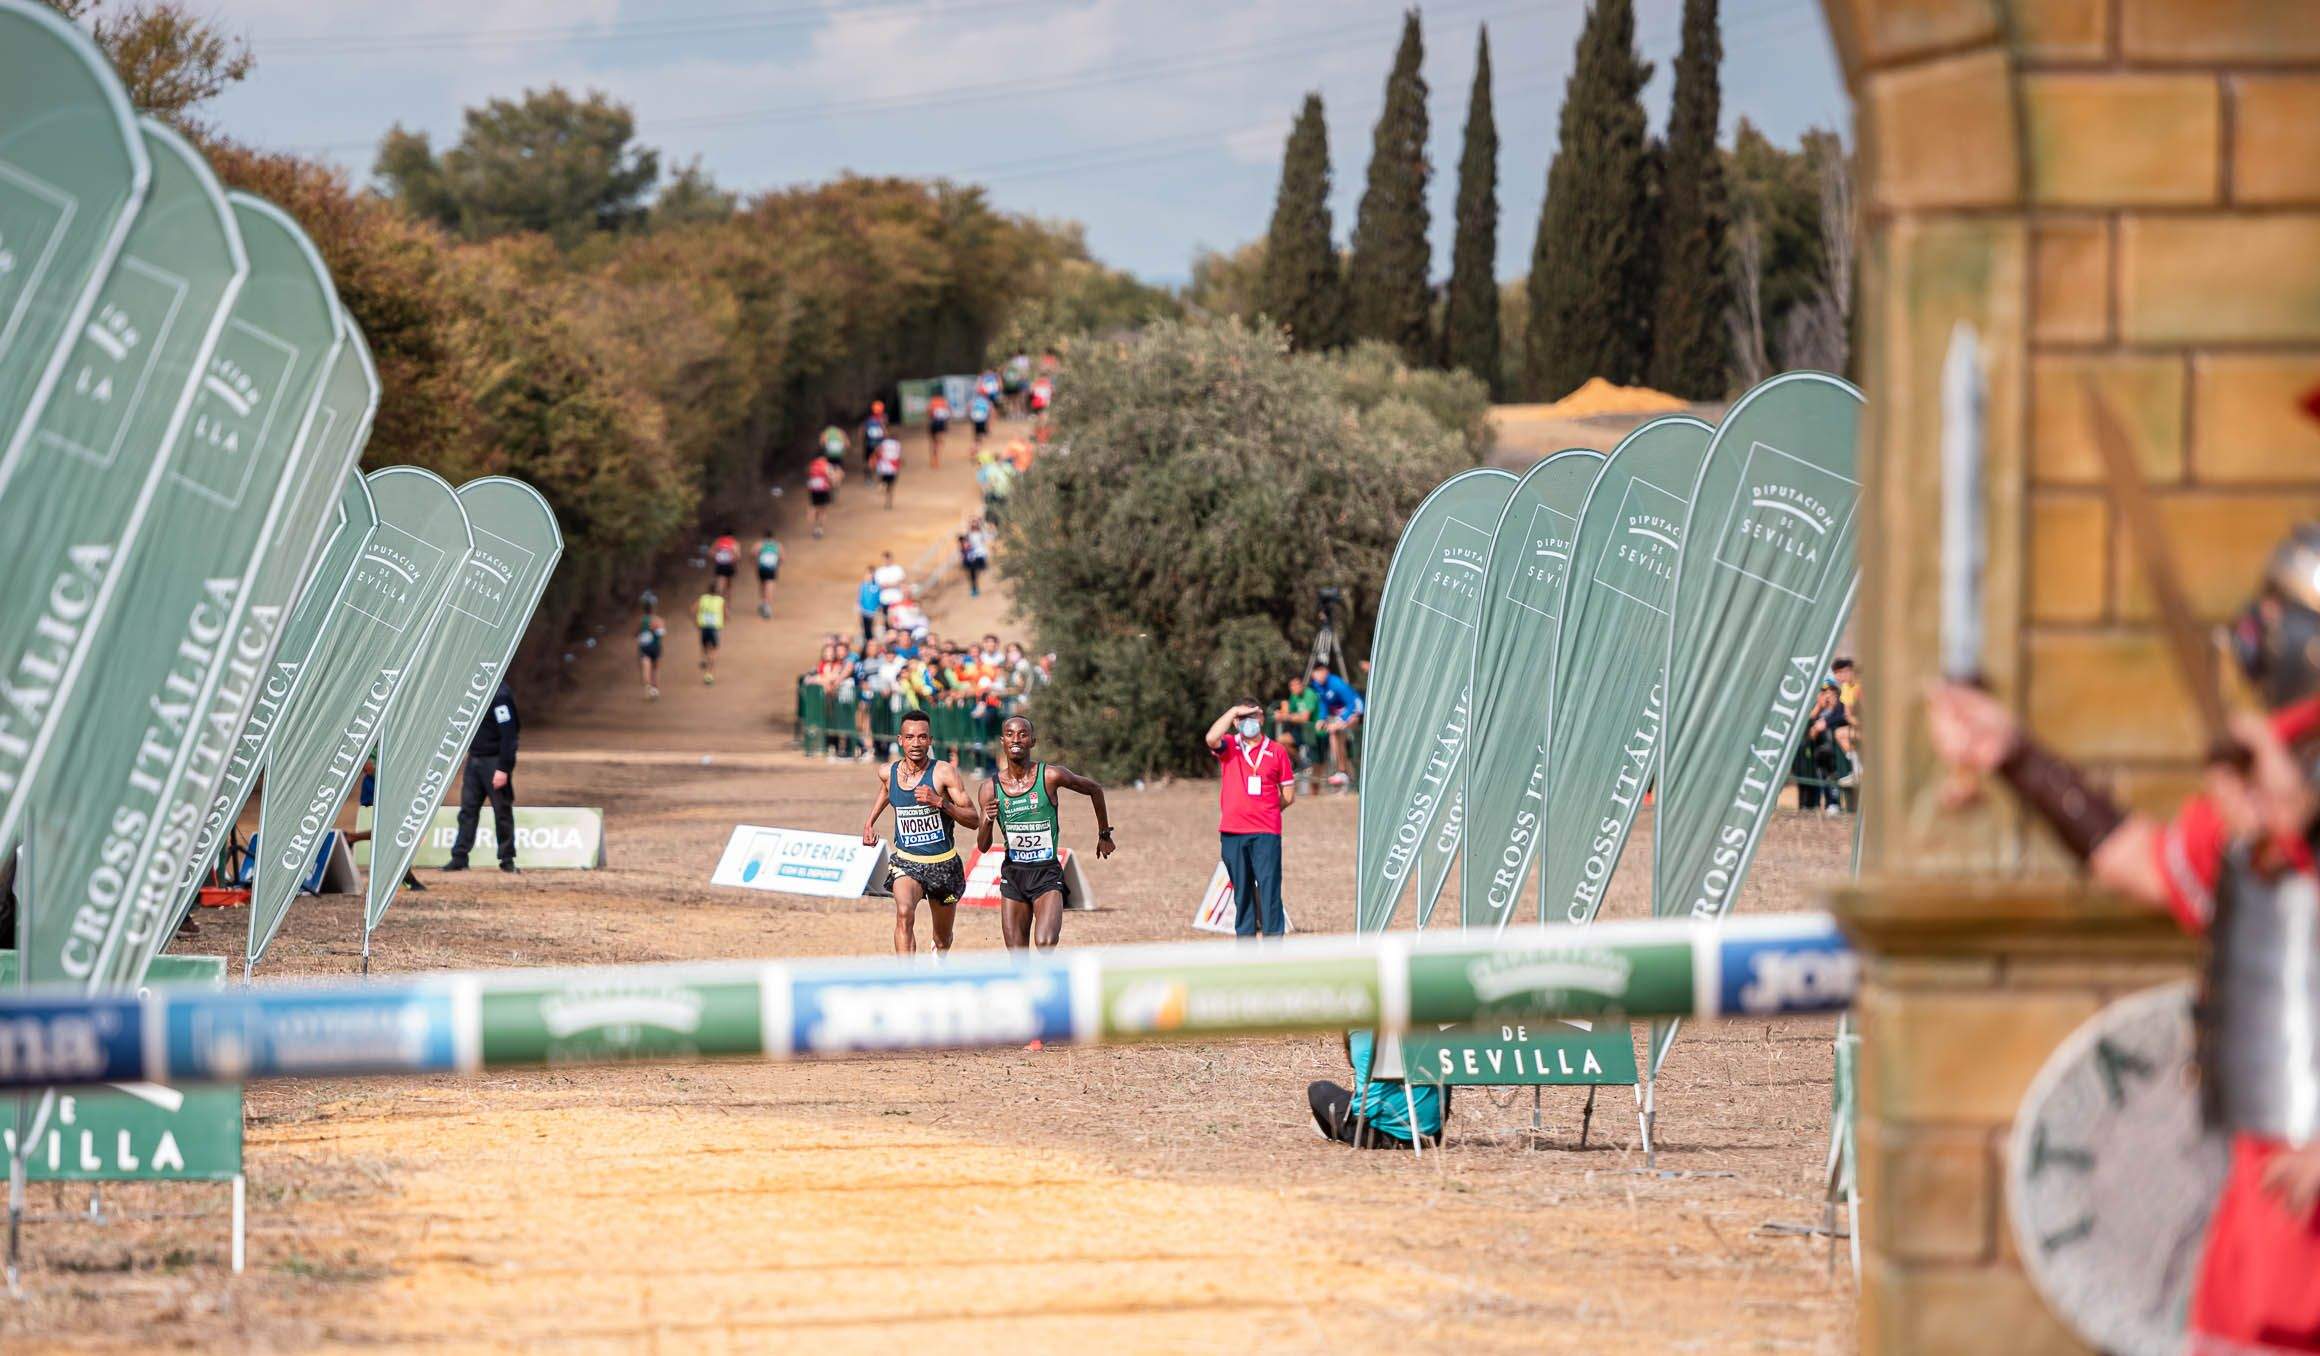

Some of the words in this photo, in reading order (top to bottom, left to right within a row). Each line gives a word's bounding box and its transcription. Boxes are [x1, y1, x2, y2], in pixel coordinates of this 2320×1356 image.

[1629, 514, 1682, 538] DIPUTAC
[1741, 518, 1818, 563] SEVILLA
[1780, 516, 1794, 529] DE
[1651, 543, 1664, 556] DE
[1734, 653, 1819, 816] ITÁLICA
[281, 780, 337, 872] CROSS
[328, 664, 402, 790] ITÁLICA
[394, 767, 443, 850] CROSS
[434, 657, 500, 771] ITÁLICA
[60, 804, 149, 979] CROSS
[129, 577, 242, 796] ITÁLICA
[901, 815, 939, 834] WORKU
[1016, 835, 1042, 848] 252
[1383, 791, 1432, 881] CROSS
[782, 842, 858, 863] LOTERIAS
[1487, 809, 1536, 909] CROSS
[1567, 816, 1621, 926] CROSS
[1502, 1025, 1528, 1042] DE
[1437, 1048, 1603, 1075] SEVILLA
